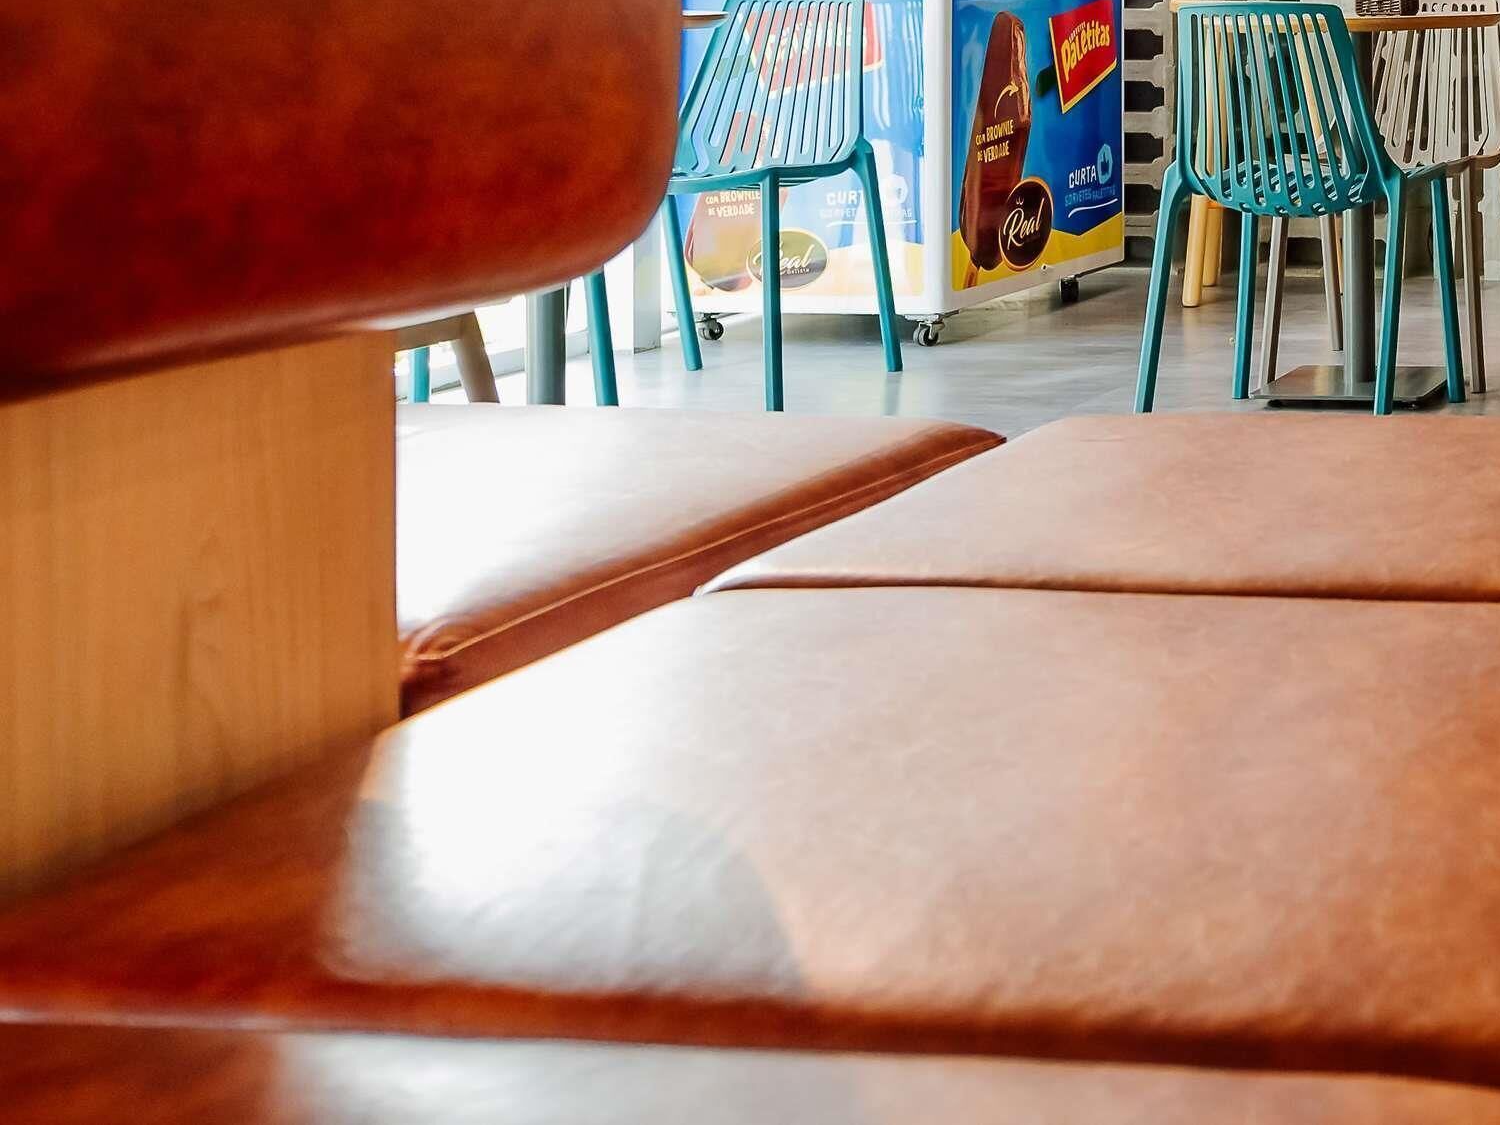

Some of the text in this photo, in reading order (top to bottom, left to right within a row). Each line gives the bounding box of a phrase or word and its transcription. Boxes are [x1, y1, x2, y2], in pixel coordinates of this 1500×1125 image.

[986, 119, 1014, 142] BROWNIE
[983, 140, 1010, 163] VERDADE
[1068, 165, 1097, 189] CURTA
[716, 203, 756, 218] VERDADE
